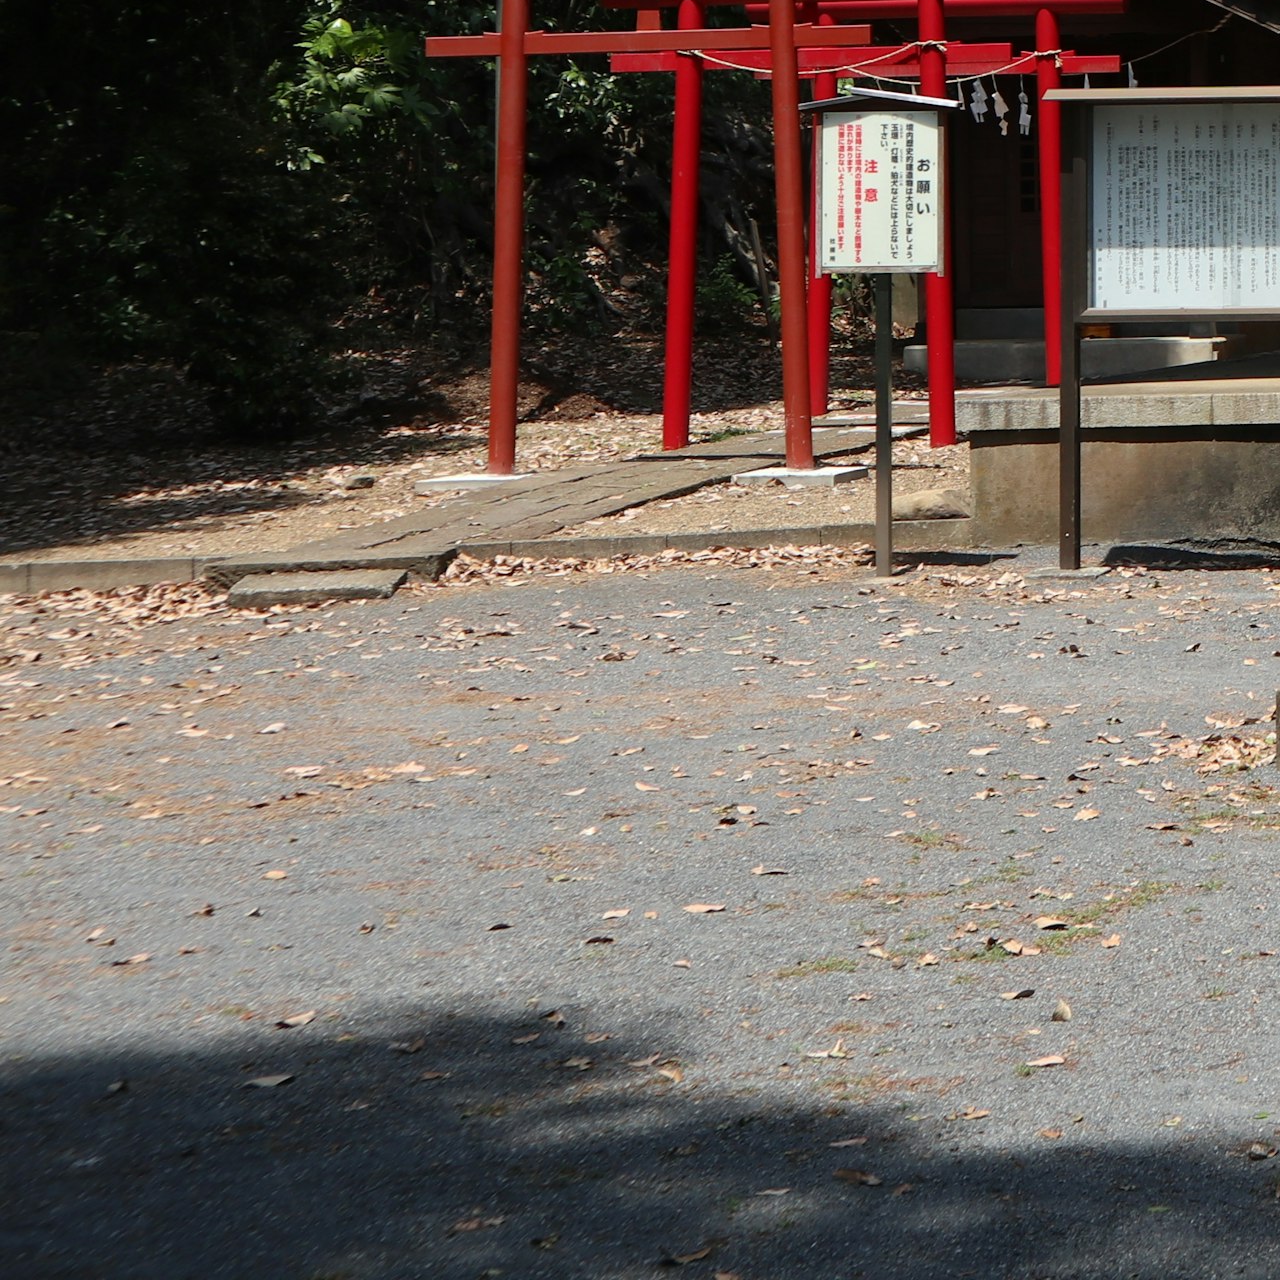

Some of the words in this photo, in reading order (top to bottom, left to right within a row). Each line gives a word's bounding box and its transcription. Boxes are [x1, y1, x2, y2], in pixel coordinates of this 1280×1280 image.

[880, 123, 889, 151] 下さい。
[864, 159, 878, 203] 注意
[917, 159, 930, 215] お願い
